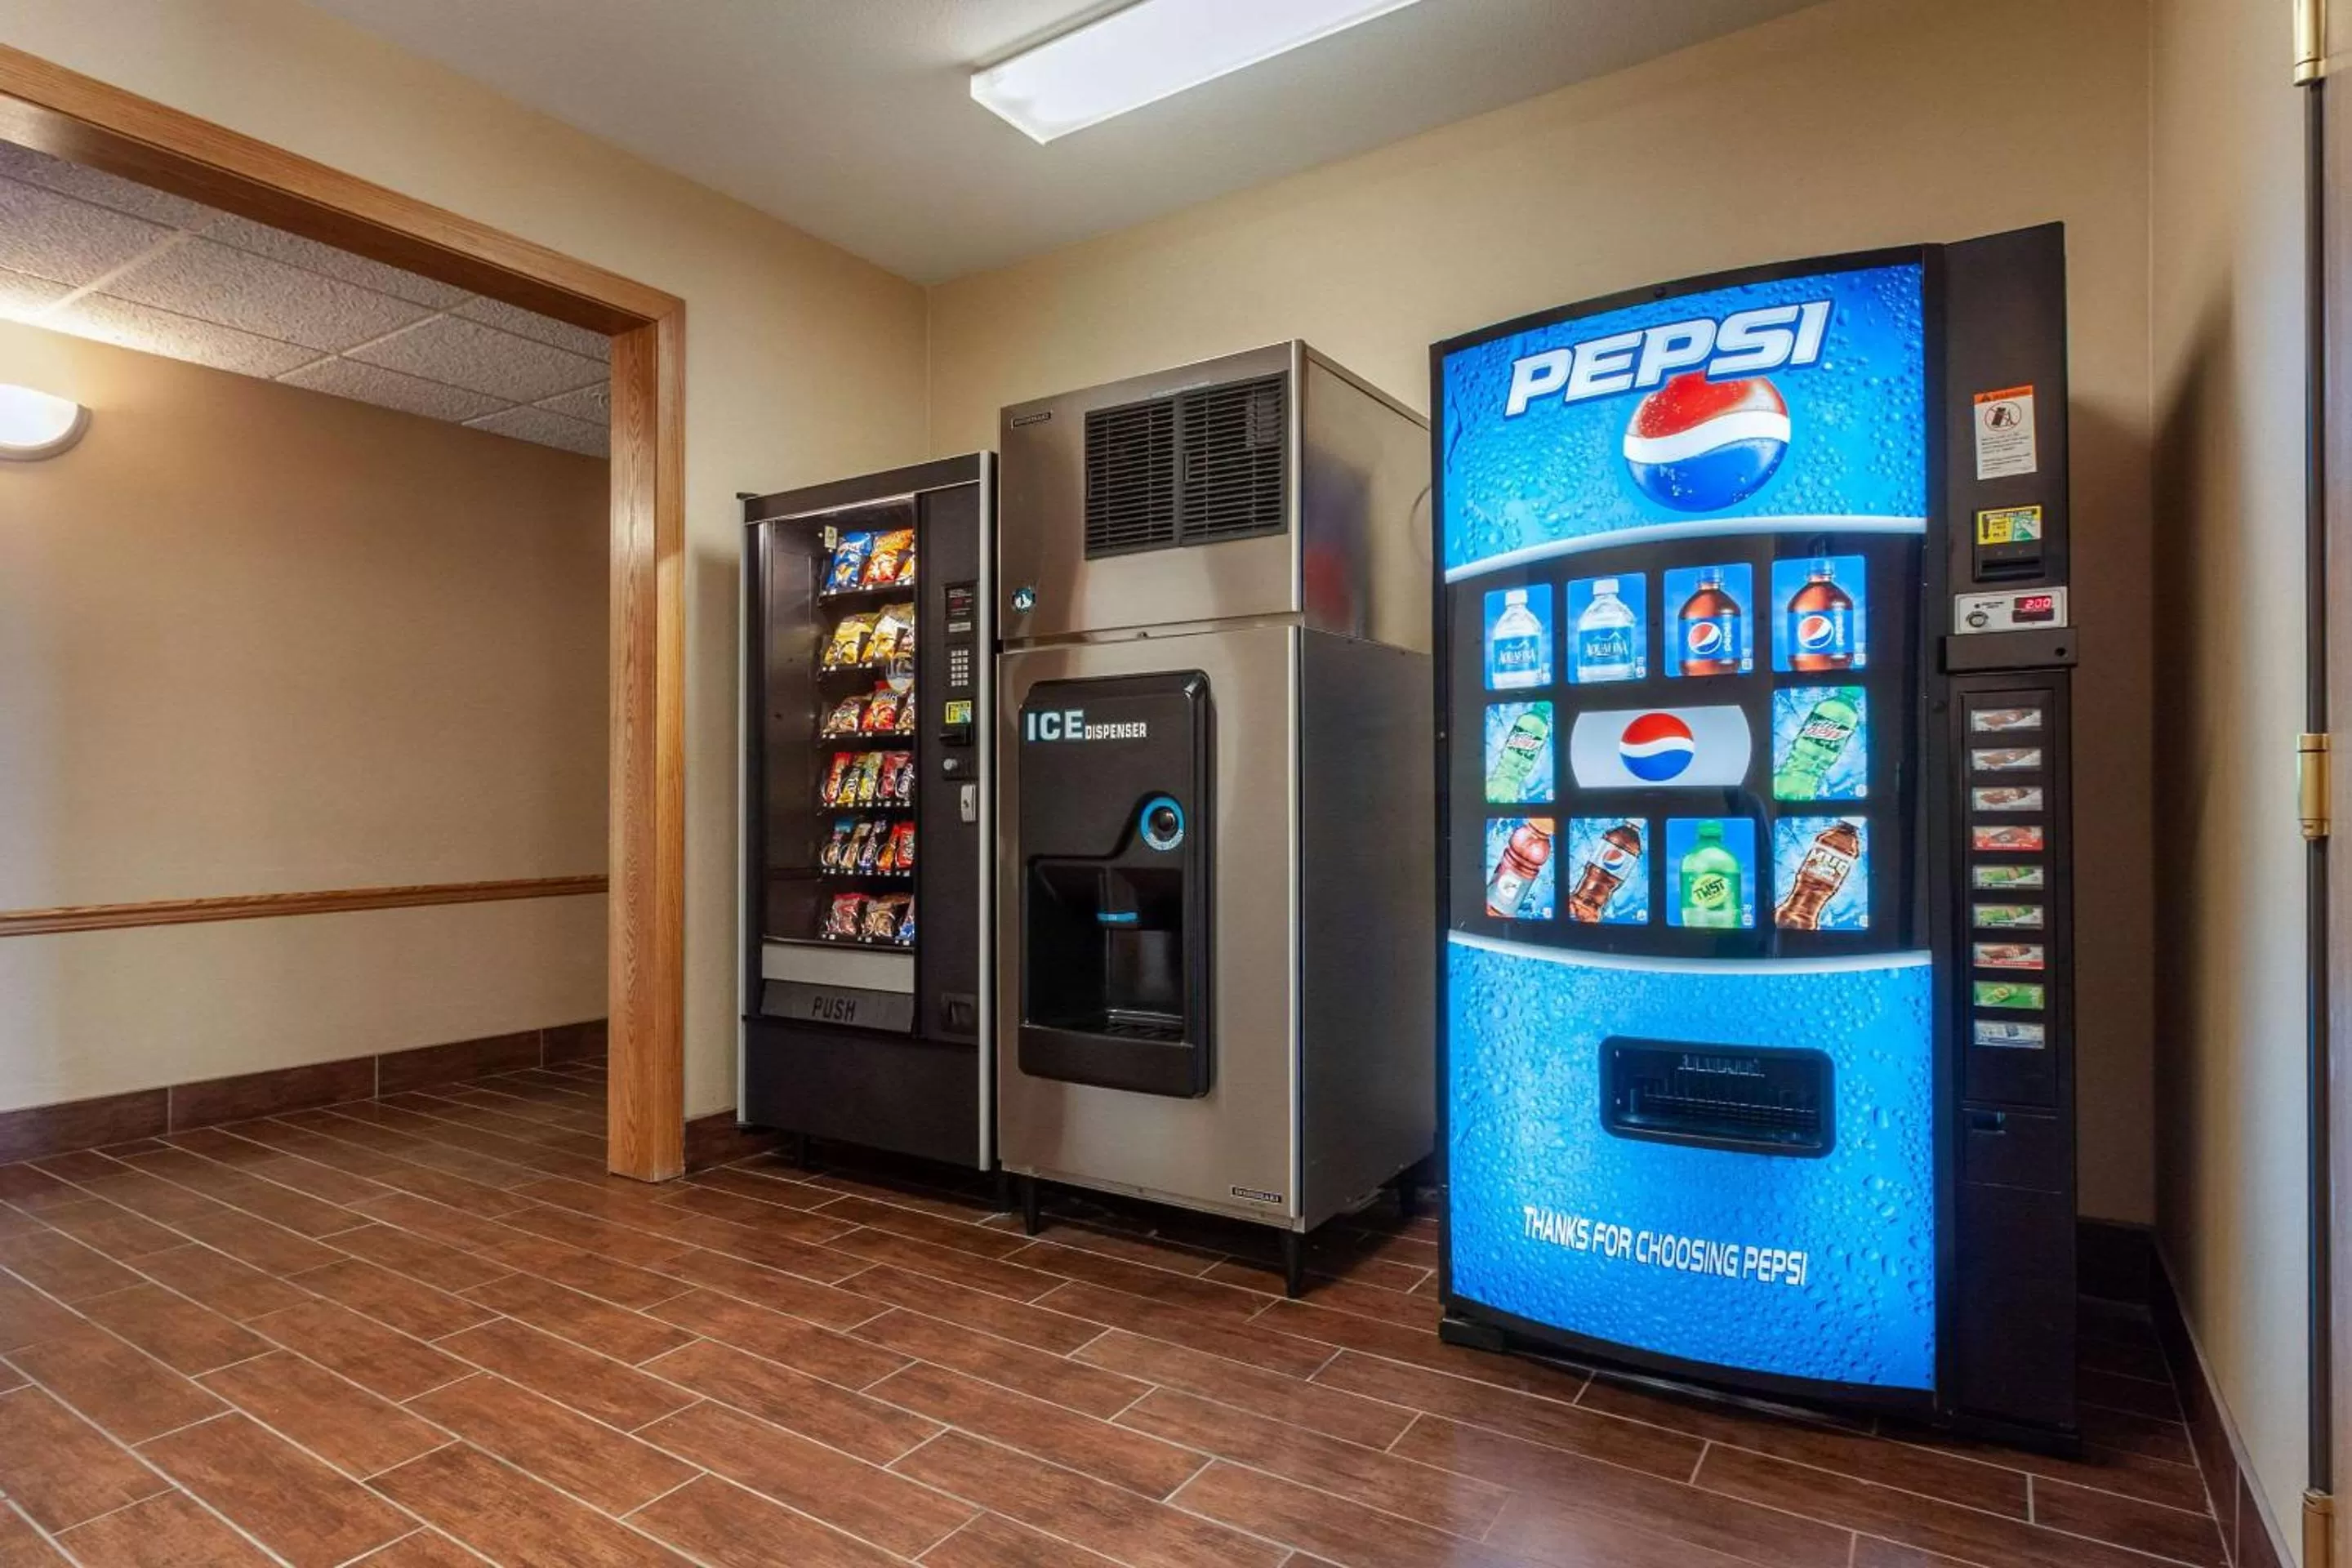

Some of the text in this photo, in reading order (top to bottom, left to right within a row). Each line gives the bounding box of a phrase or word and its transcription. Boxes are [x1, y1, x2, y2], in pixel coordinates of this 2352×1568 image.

[1504, 300, 1831, 416] PEPSI
[1027, 709, 1147, 742] ICE DISPENSER
[812, 996, 857, 1022] PUSH
[1523, 1205, 1809, 1286] THANKS FOR CHOOSING PEPSI
